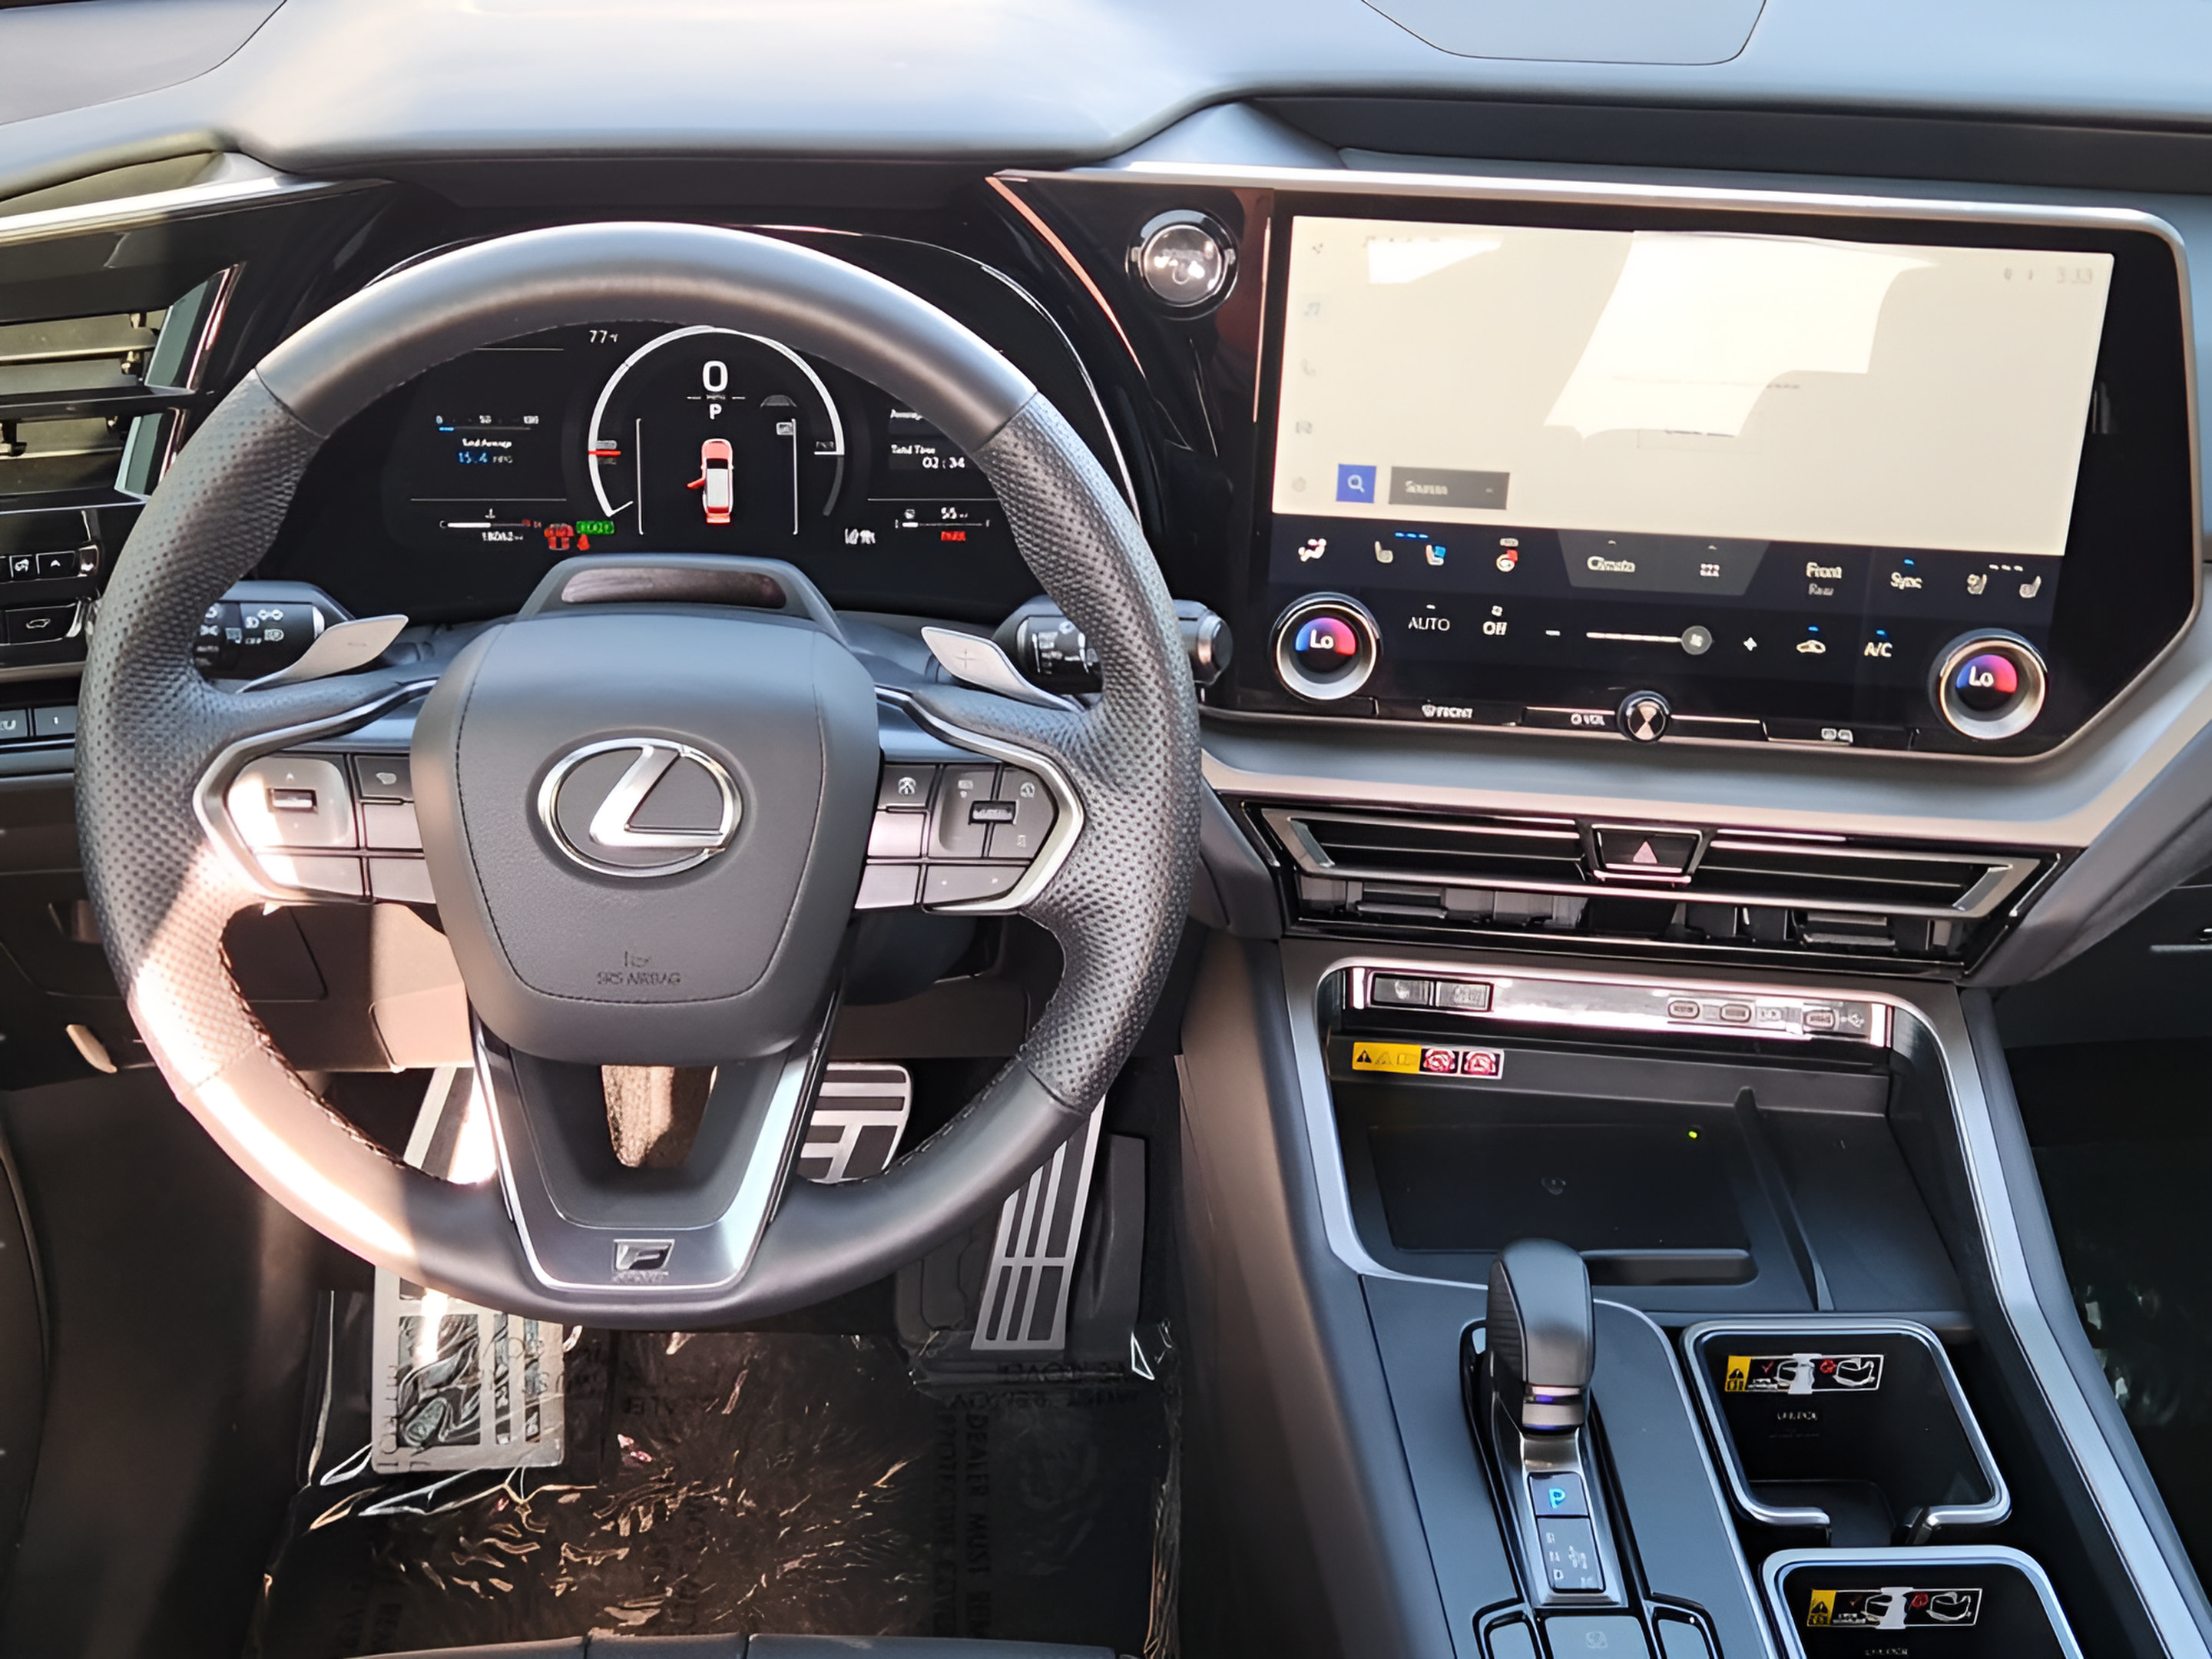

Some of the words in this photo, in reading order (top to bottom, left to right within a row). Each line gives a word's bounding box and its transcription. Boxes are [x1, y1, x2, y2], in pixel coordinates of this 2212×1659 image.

[702, 360, 728, 392] 0
[709, 403, 722, 419] P
[1806, 561, 1842, 580] Front
[1890, 571, 1923, 591] Sync
[1408, 617, 1451, 632] AUTO
[1310, 629, 1334, 649] Lo
[1864, 641, 1893, 658] A/C
[1969, 665, 1995, 687] Lo
[1548, 1488, 1566, 1509] P
